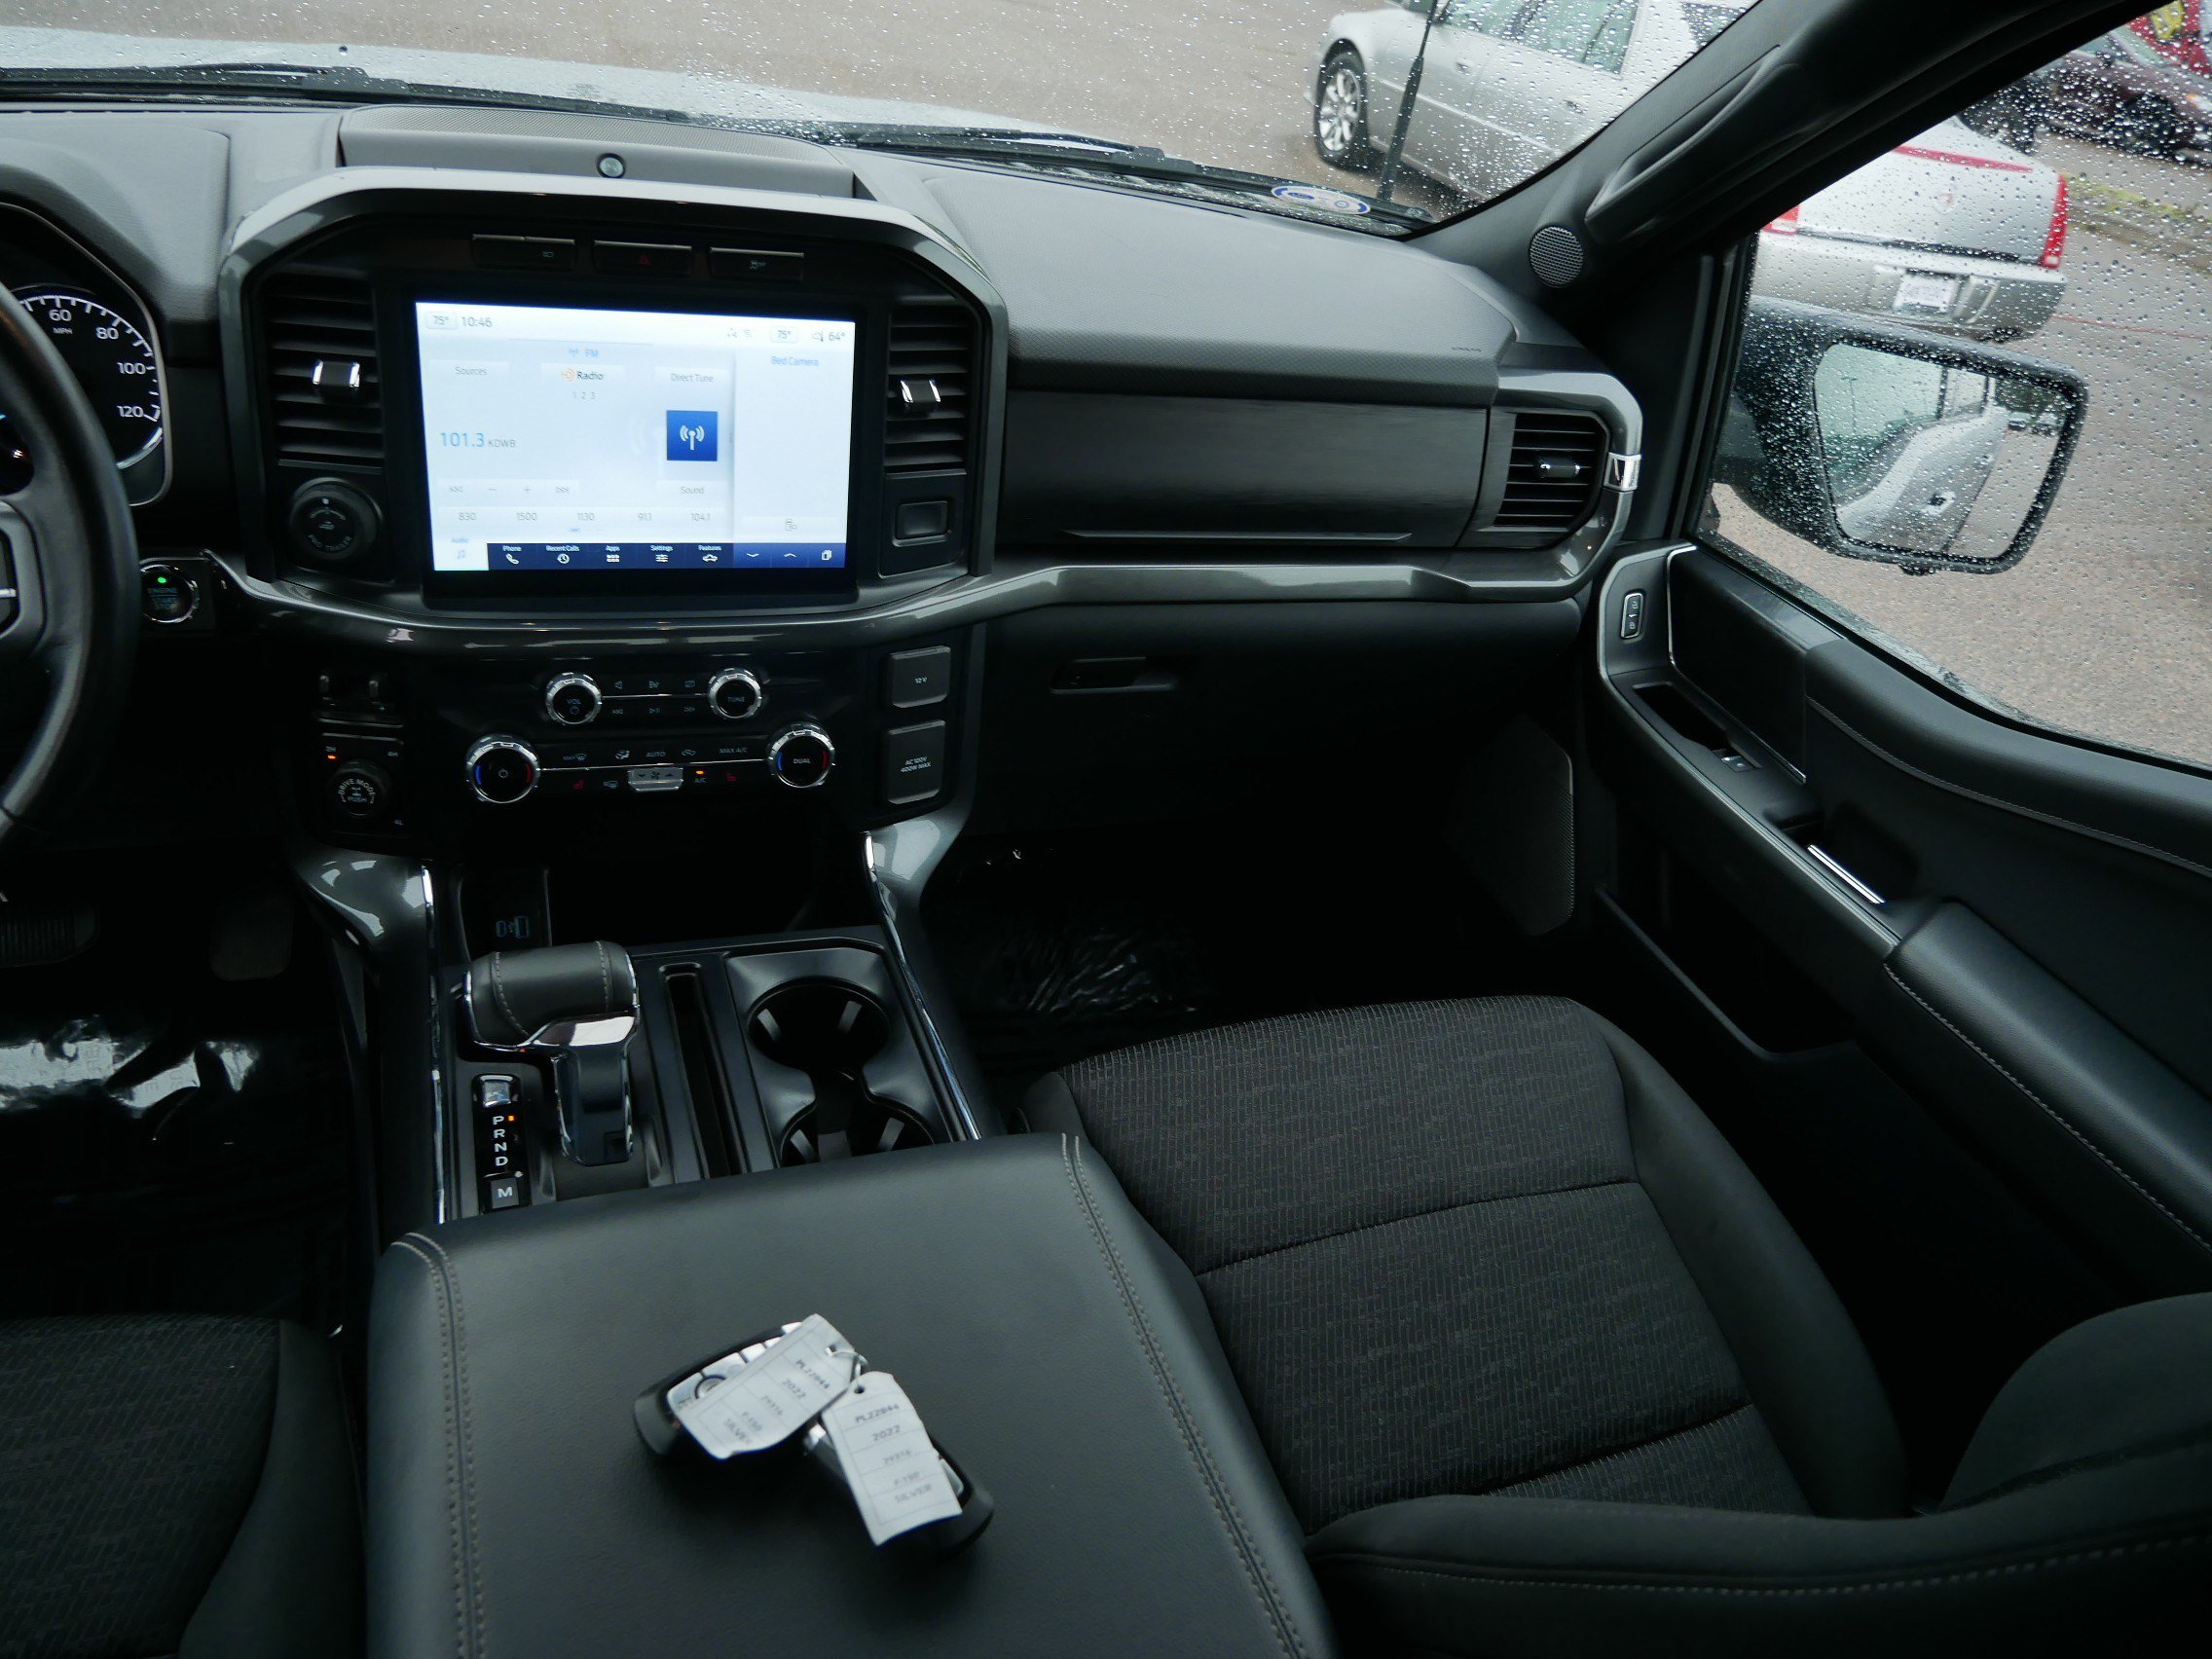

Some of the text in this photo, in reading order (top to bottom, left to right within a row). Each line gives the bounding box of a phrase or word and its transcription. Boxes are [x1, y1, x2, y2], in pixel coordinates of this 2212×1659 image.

[50, 309, 72, 323] 60
[461, 316, 493, 328] 10:46
[95, 327, 119, 341] 80
[829, 331, 847, 342] 64°
[770, 355, 820, 367] Bed Camera
[117, 362, 146, 375] 100
[454, 366, 488, 376] Sources
[576, 370, 605, 381] Radio
[670, 373, 715, 384] Direct Tune
[117, 405, 144, 419] 120
[440, 432, 517, 449] 101.3 KDWB
[680, 486, 705, 495] Sound
[458, 512, 477, 522] 830
[516, 512, 537, 522] 1500
[576, 512, 596, 522] 1130
[502, 544, 522, 553] Phone
[565, 544, 580, 553] Calls
[606, 545, 620, 554] Apps
[650, 544, 674, 554] Settings
[493, 1116, 505, 1125] P
[494, 1128, 506, 1139] R
[495, 1142, 507, 1153] N
[495, 1156, 508, 1166] D
[498, 1187, 513, 1198] M
[782, 1379, 806, 1399] 2022
[872, 1424, 902, 1441] 2022
[894, 1483, 932, 1503] SILVER
